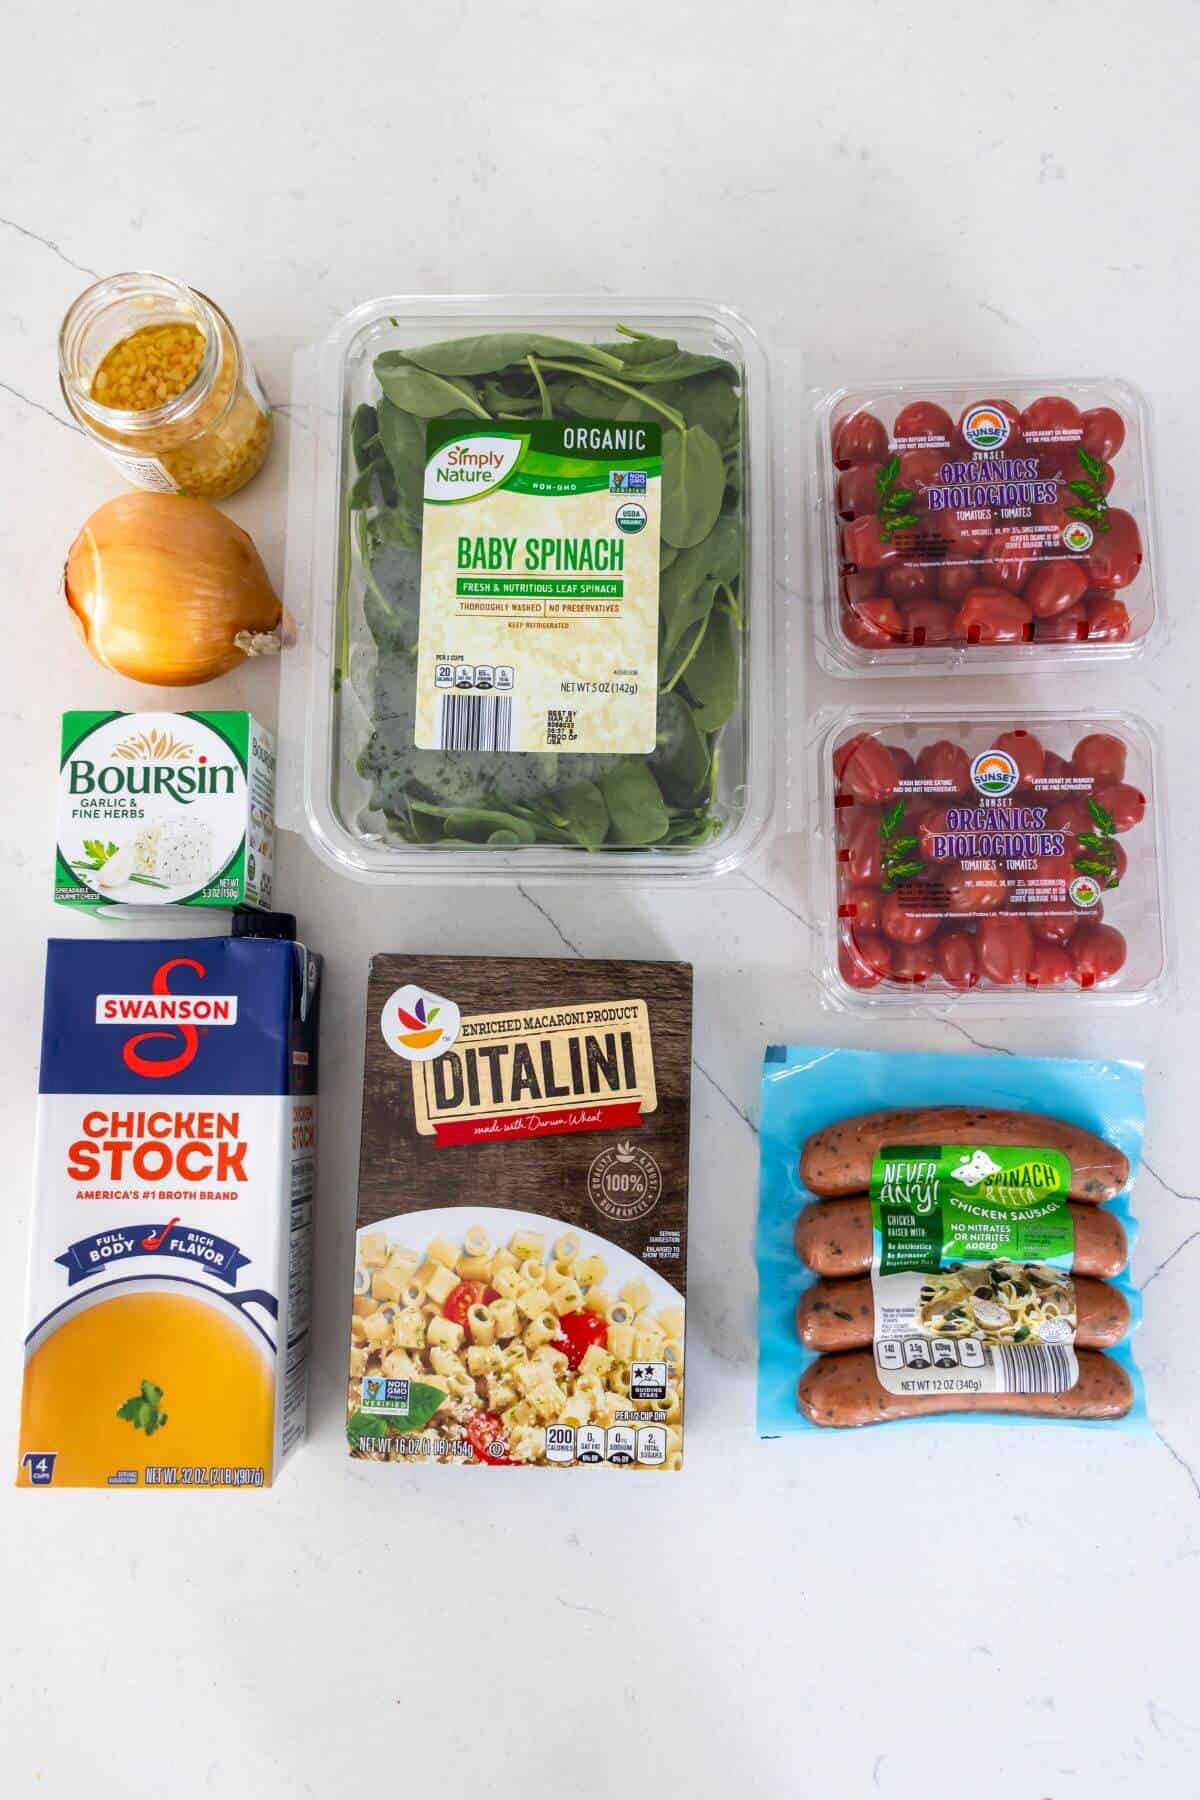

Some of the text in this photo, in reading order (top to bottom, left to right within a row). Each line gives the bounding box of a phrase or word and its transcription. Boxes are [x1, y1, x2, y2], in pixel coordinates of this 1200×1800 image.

[563, 427, 646, 450] ORGANIC
[966, 427, 1007, 438] SUNSET
[447, 446, 504, 468] Simply
[973, 450, 1005, 460] SUNSET
[941, 458, 1039, 484] ORGANICS
[532, 483, 577, 491] NON-GMO
[928, 481, 1057, 511] BIOLOGIQUES
[956, 507, 1032, 520] TOMATOES TOMATES
[457, 537, 624, 571] BABY SPINACH
[463, 583, 617, 593] FRESH & NUTRITIOUS LEAF SPINACH
[460, 602, 542, 611] THOROUGHLY WASHED
[549, 603, 620, 613] NO PRESERVATIVES
[560, 682, 638, 695] NET WT 5 OZ (142g)
[975, 772, 1017, 784] SUNSET
[80, 798, 137, 808] GARLIC &
[979, 798, 1013, 807] SUNSET
[72, 809, 145, 819] FINE HERBS
[946, 807, 1047, 831] ORGANICS
[932, 832, 1065, 858] BIOLOGIQUES
[961, 859, 1038, 871] TOMATOES TOMATES
[219, 878, 230, 888] NET
[104, 999, 229, 1020] SWANSON
[462, 1006, 639, 1037] ENRICHED MACARONI PRODUCT
[432, 1031, 637, 1111] DITALINI
[82, 1111, 239, 1139] CHICKEN
[473, 1111, 602, 1135] made with Durum Wheat
[67, 1140, 248, 1182] STOCK
[592, 1153, 657, 1190] QUALITY TRUST
[884, 1163, 937, 1185] NEVER
[984, 1164, 1056, 1188] SPINACH
[606, 1174, 643, 1192] 100%
[75, 1190, 239, 1200] AMERICA'S #1 BROTH BRAND
[877, 1180, 940, 1212] ANY!
[998, 1187, 1036, 1206] FETA
[599, 1200, 649, 1217] GUARANTEE
[950, 1198, 1007, 1220] CHICKEN
[887, 1215, 915, 1226] CHICKEN
[968, 1224, 1011, 1233] NITRATES
[96, 1234, 126, 1246] FULL
[187, 1233, 215, 1247] RICH
[954, 1233, 1010, 1242] OR NITRITES
[89, 1240, 135, 1262] BODY
[169, 1239, 225, 1266] FLAVOR
[966, 1242, 999, 1250] ADDED
[387, 1387, 407, 1395] GMO
[901, 1380, 982, 1391] NET WT 12 OZ (340g)
[364, 1400, 407, 1408] VERIFIED
[615, 1411, 628, 1420] PER
[640, 1411, 653, 1421] CUP
[654, 1411, 667, 1421] DRY
[548, 1429, 573, 1444] 200
[360, 1437, 376, 1452] NET
[378, 1437, 392, 1453] WT
[396, 1438, 406, 1454] 16
[408, 1438, 420, 1455] OZ
[452, 1440, 473, 1457] 454g
[35, 1458, 48, 1472] 4
[32, 1472, 50, 1480] CUPS
[146, 1468, 162, 1485] NET
[181, 1468, 193, 1485] 32
